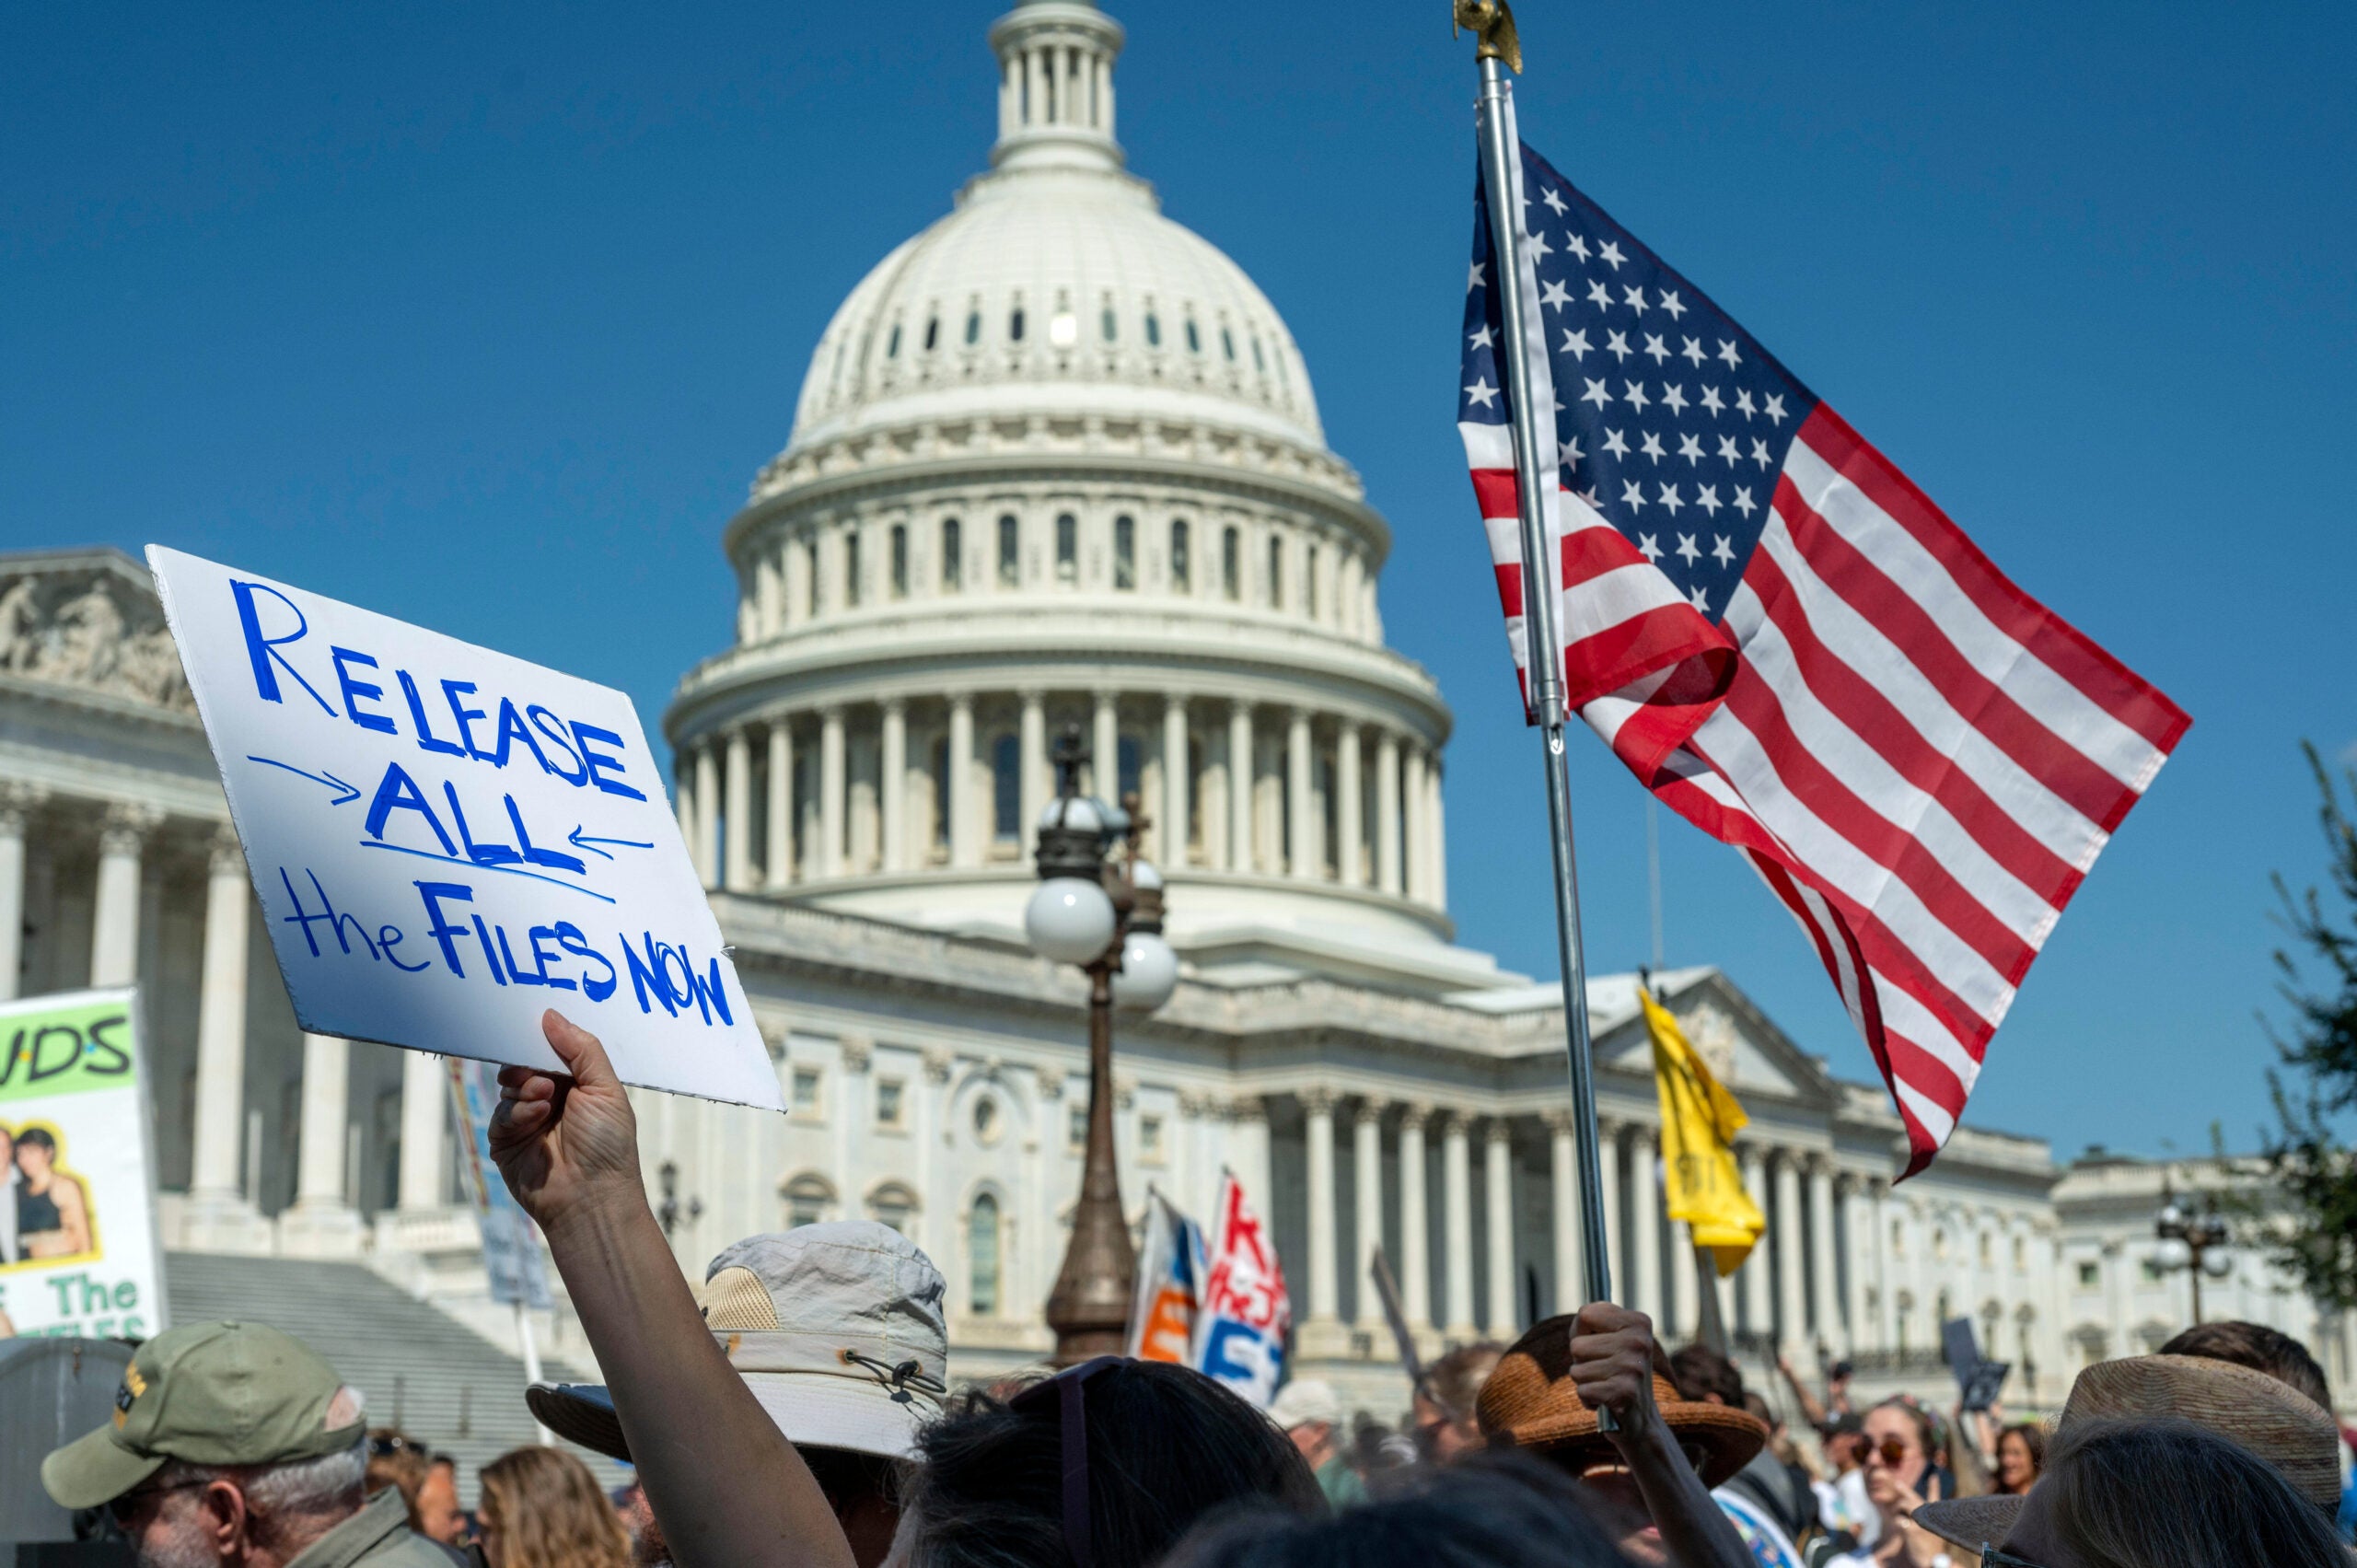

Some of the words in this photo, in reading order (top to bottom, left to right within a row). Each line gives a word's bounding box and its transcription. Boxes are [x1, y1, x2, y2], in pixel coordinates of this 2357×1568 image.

[229, 578, 647, 803] RELEASE
[364, 761, 587, 875] ALL
[280, 866, 431, 972] the
[412, 879, 618, 1004] FILES
[619, 930, 735, 1028] NOW
[47, 1272, 137, 1316] The
